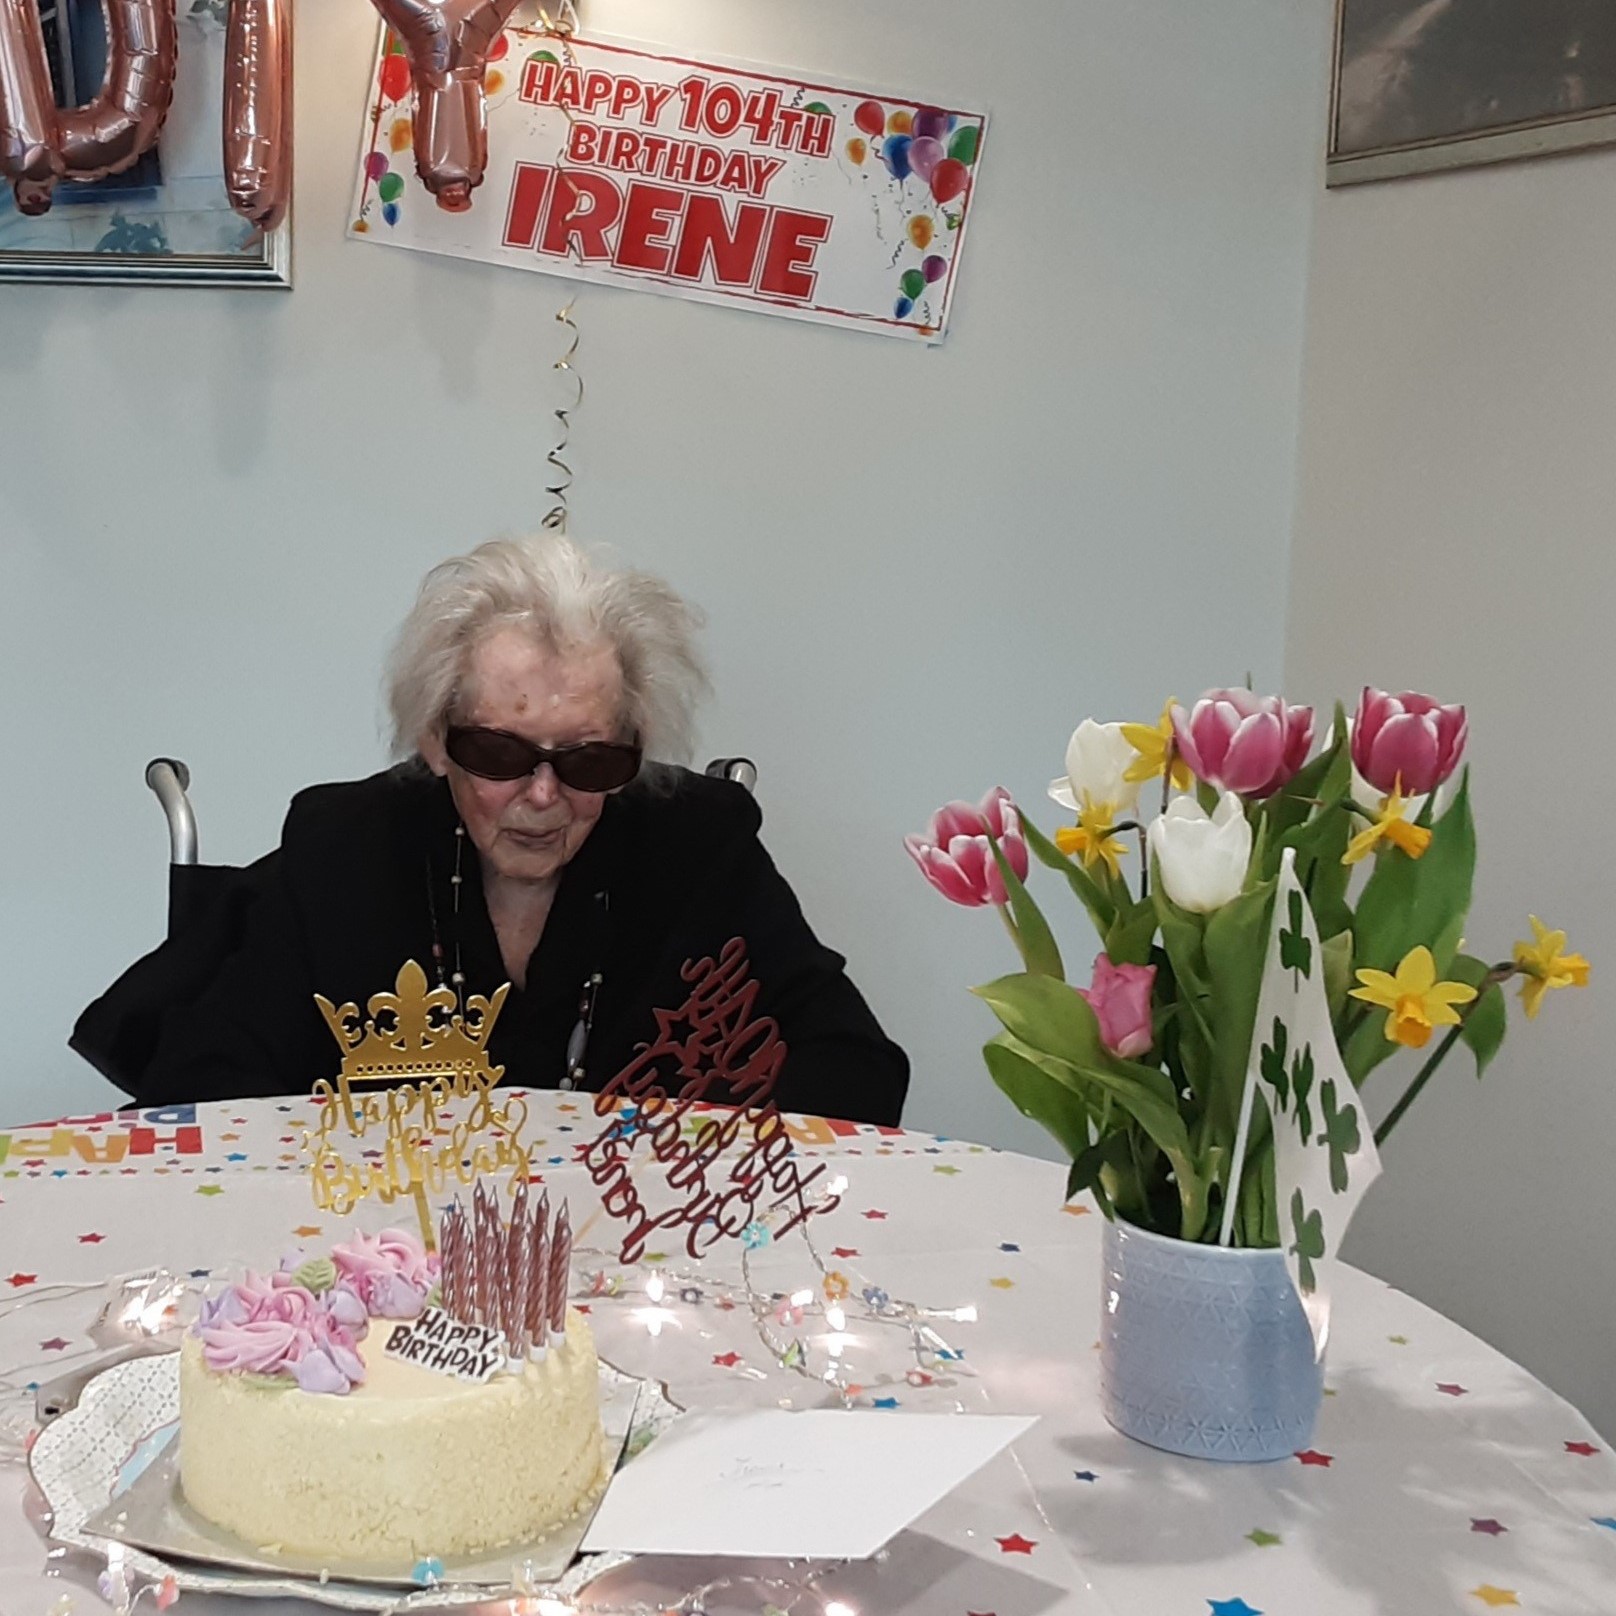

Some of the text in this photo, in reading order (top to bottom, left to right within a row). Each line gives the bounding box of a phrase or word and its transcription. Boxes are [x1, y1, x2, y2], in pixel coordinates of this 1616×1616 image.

[520, 60, 836, 158] HAPPY 104TH
[565, 123, 787, 199] BIRTHDAY
[502, 160, 833, 301] IRENE
[301, 1065, 506, 1148] Happy
[0, 1126, 204, 1167] HAP
[385, 1325, 499, 1378] BIRTHDAY
[414, 1308, 499, 1353] HAPPY
